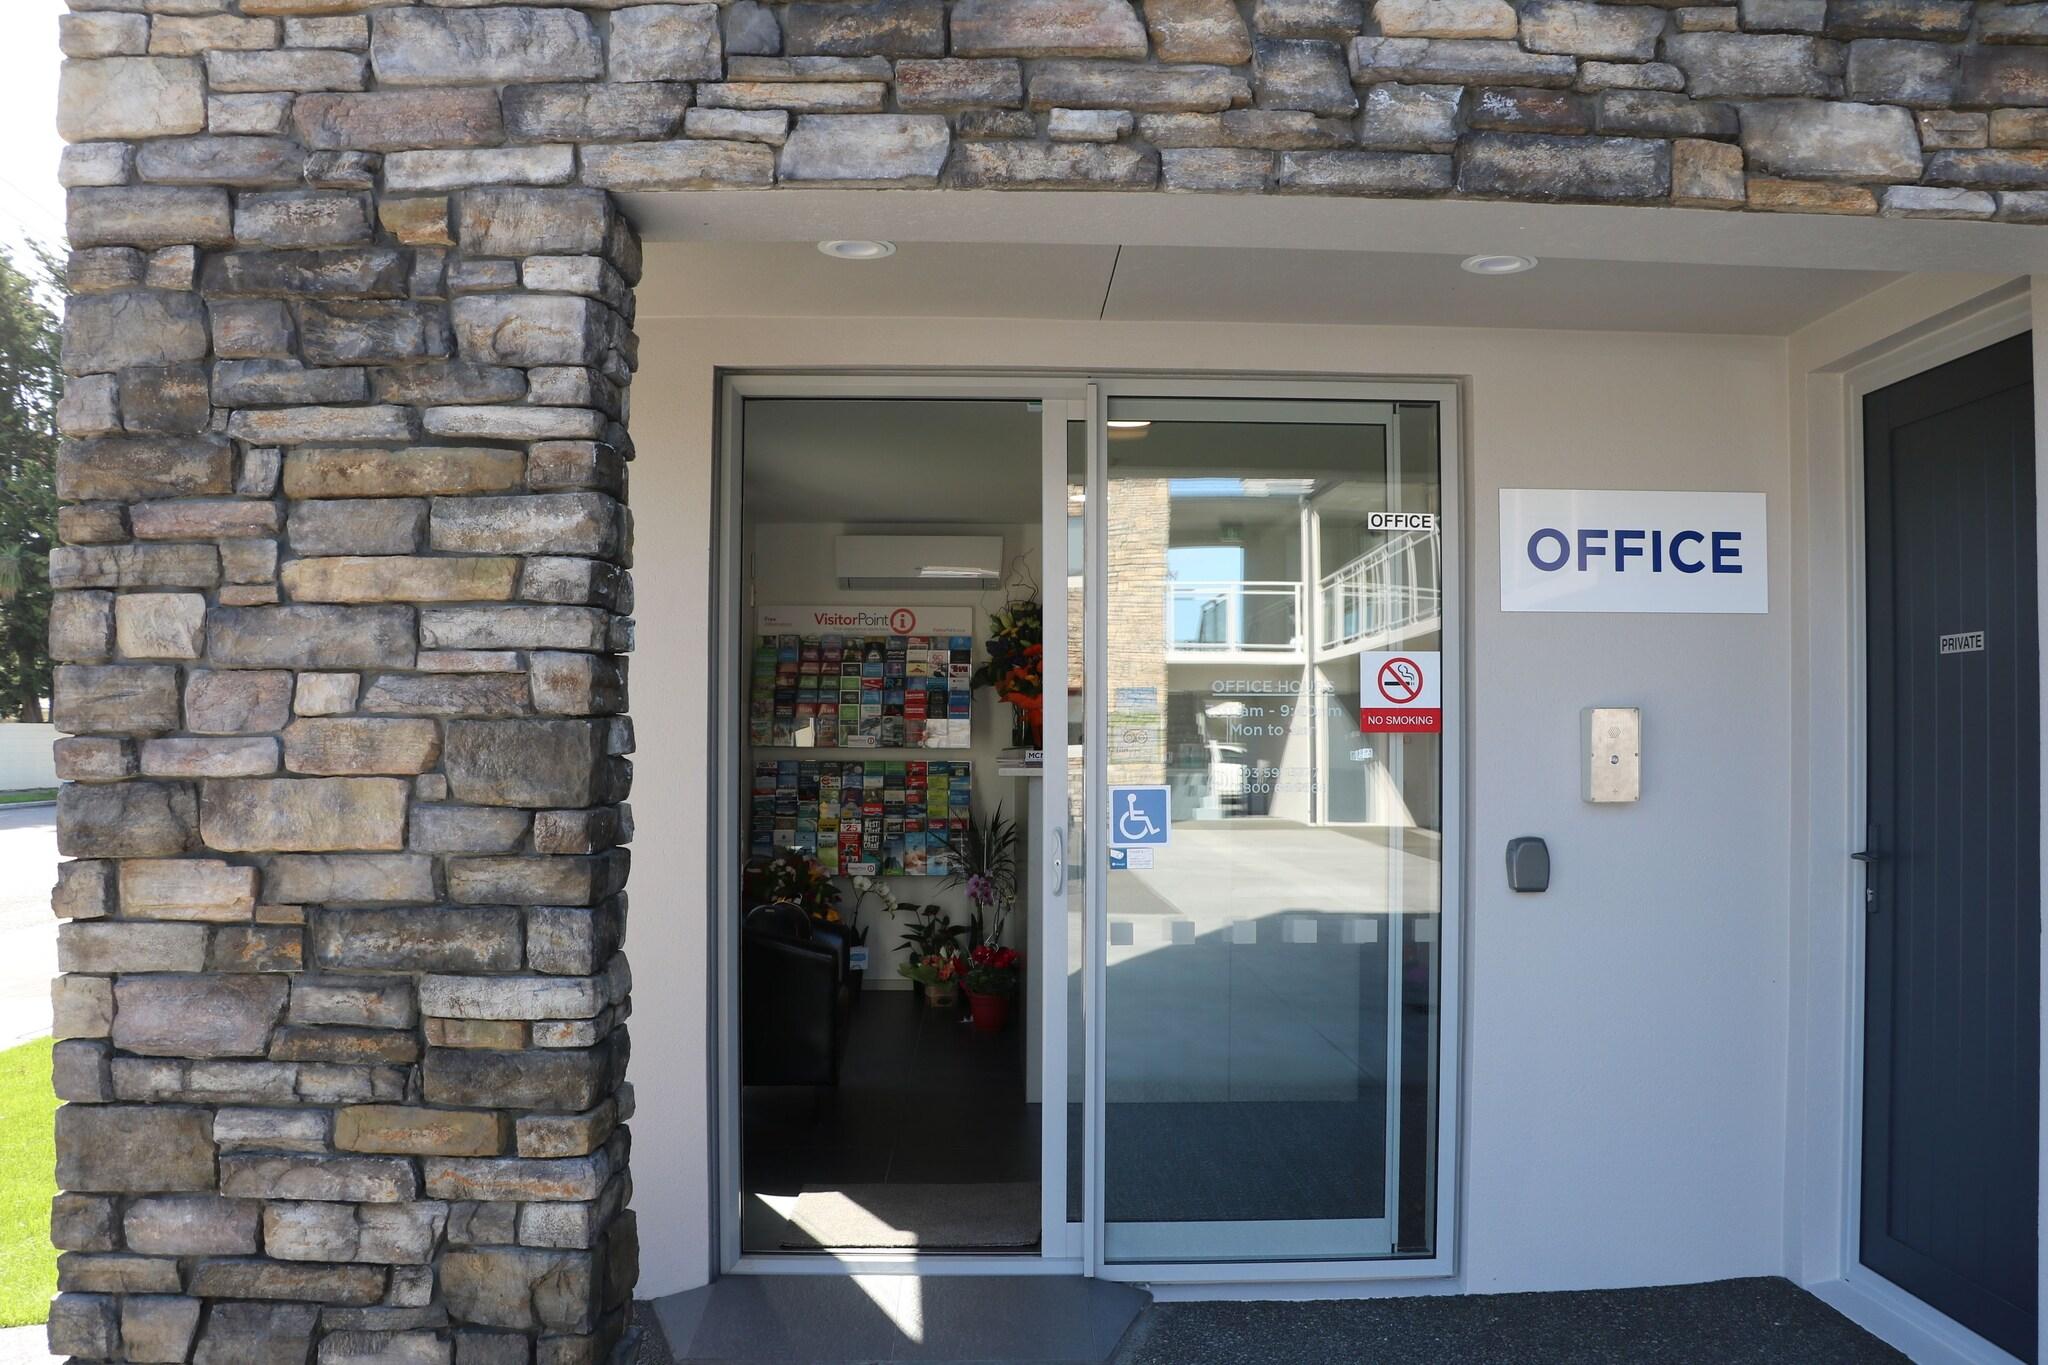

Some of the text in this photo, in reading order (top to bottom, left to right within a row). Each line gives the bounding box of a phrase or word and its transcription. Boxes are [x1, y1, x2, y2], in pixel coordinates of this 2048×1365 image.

[1371, 514, 1431, 528] OFFICE
[1527, 528, 1743, 574] OFFICE
[814, 612, 889, 626] VisitorPoint
[1942, 635, 1982, 652] PRIVATE
[1212, 680, 1273, 693] OFFICE
[1368, 716, 1433, 726] NO SMOKING
[1230, 724, 1263, 736] Mon
[1267, 724, 1284, 736] to
